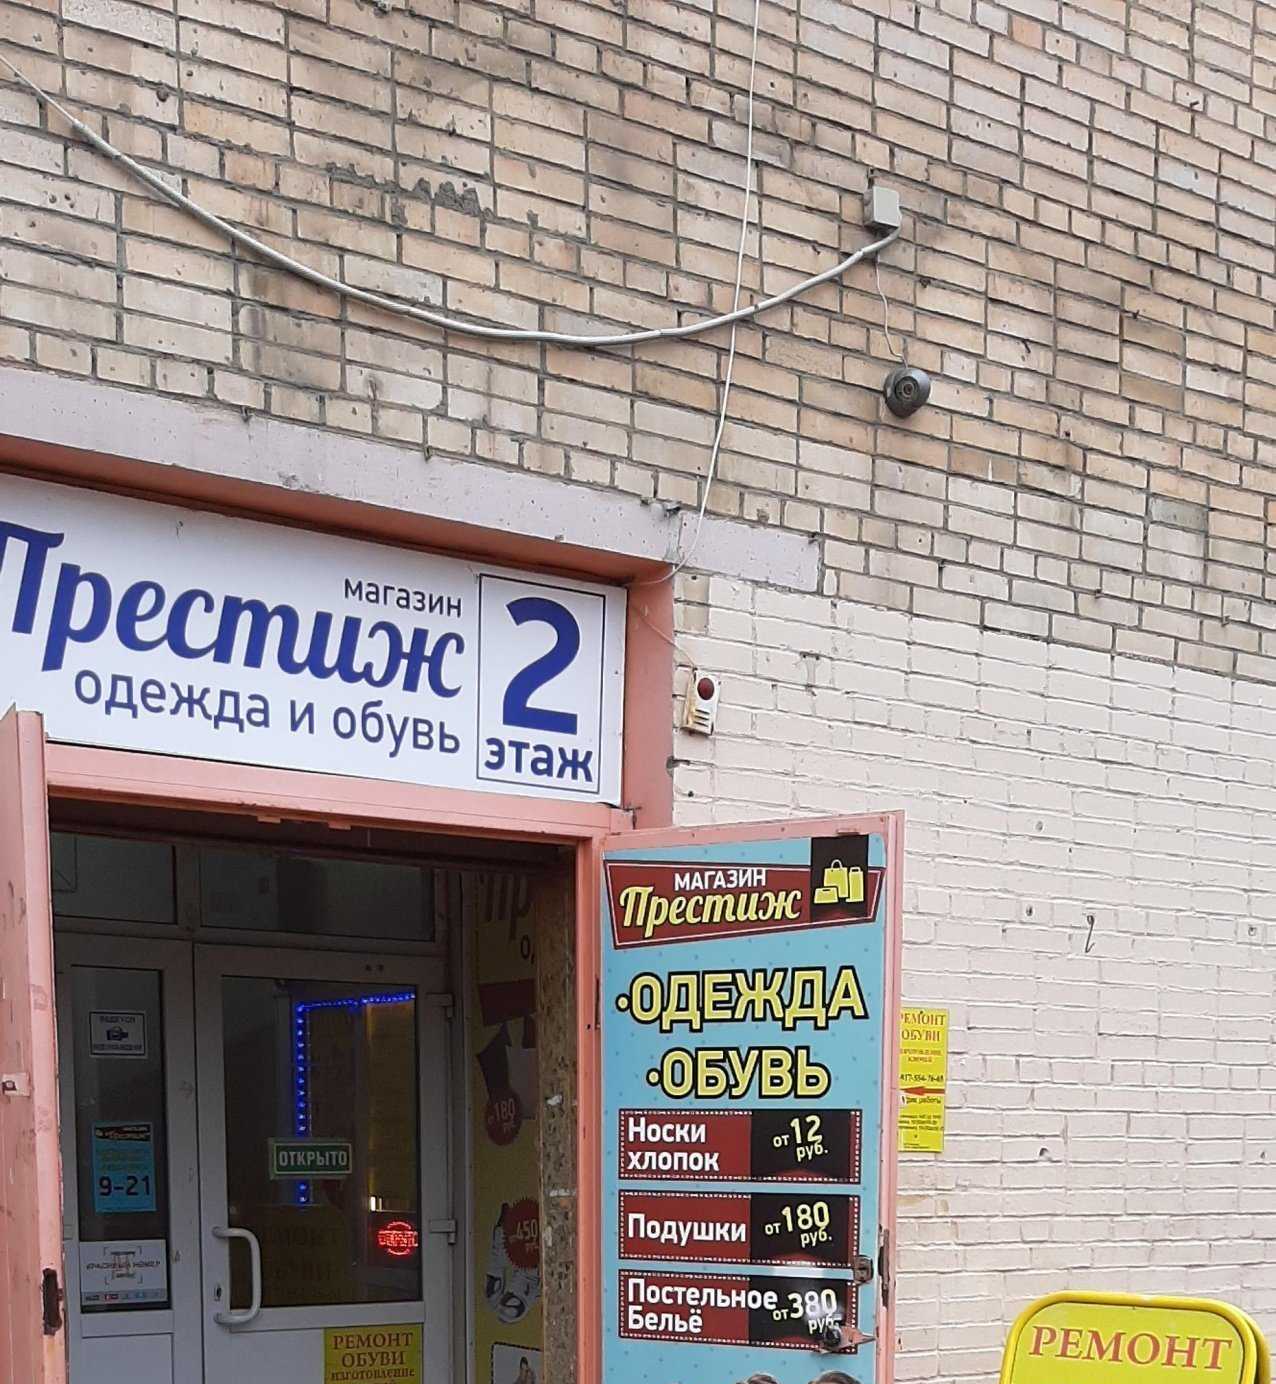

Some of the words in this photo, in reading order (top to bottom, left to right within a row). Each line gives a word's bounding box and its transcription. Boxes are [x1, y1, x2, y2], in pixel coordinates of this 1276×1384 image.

[0, 521, 465, 698] Престиж
[344, 577, 463, 619] магазин
[502, 596, 581, 736] 2
[74, 668, 271, 733] одежда
[289, 699, 315, 735] и
[333, 699, 461, 758] обувь
[484, 736, 593, 783] этаж
[674, 868, 766, 892] МАГАЗИН
[619, 886, 802, 938] Престиж
[627, 1116, 706, 1144] Носки
[772, 1134, 789, 1148] от
[790, 1115, 823, 1144] 12
[278, 1150, 348, 1167] ОТКРЫТО
[627, 1151, 720, 1172] хлопок
[796, 1139, 829, 1162] руб.
[99, 1175, 150, 1197] 9-21
[627, 1212, 747, 1247] Подушки
[764, 1222, 781, 1235] от
[781, 1201, 831, 1233] 180
[800, 1227, 833, 1249] руб.
[627, 1277, 778, 1311] Постельное
[772, 1309, 789, 1321] от
[787, 1288, 838, 1319] 380
[627, 1304, 703, 1334] Бельё
[807, 1315, 838, 1335] руб
[332, 1332, 414, 1350] РЕМОНТ
[1028, 1325, 1233, 1371] РЕМОНТ
[341, 1350, 406, 1368] ОБУВИ
